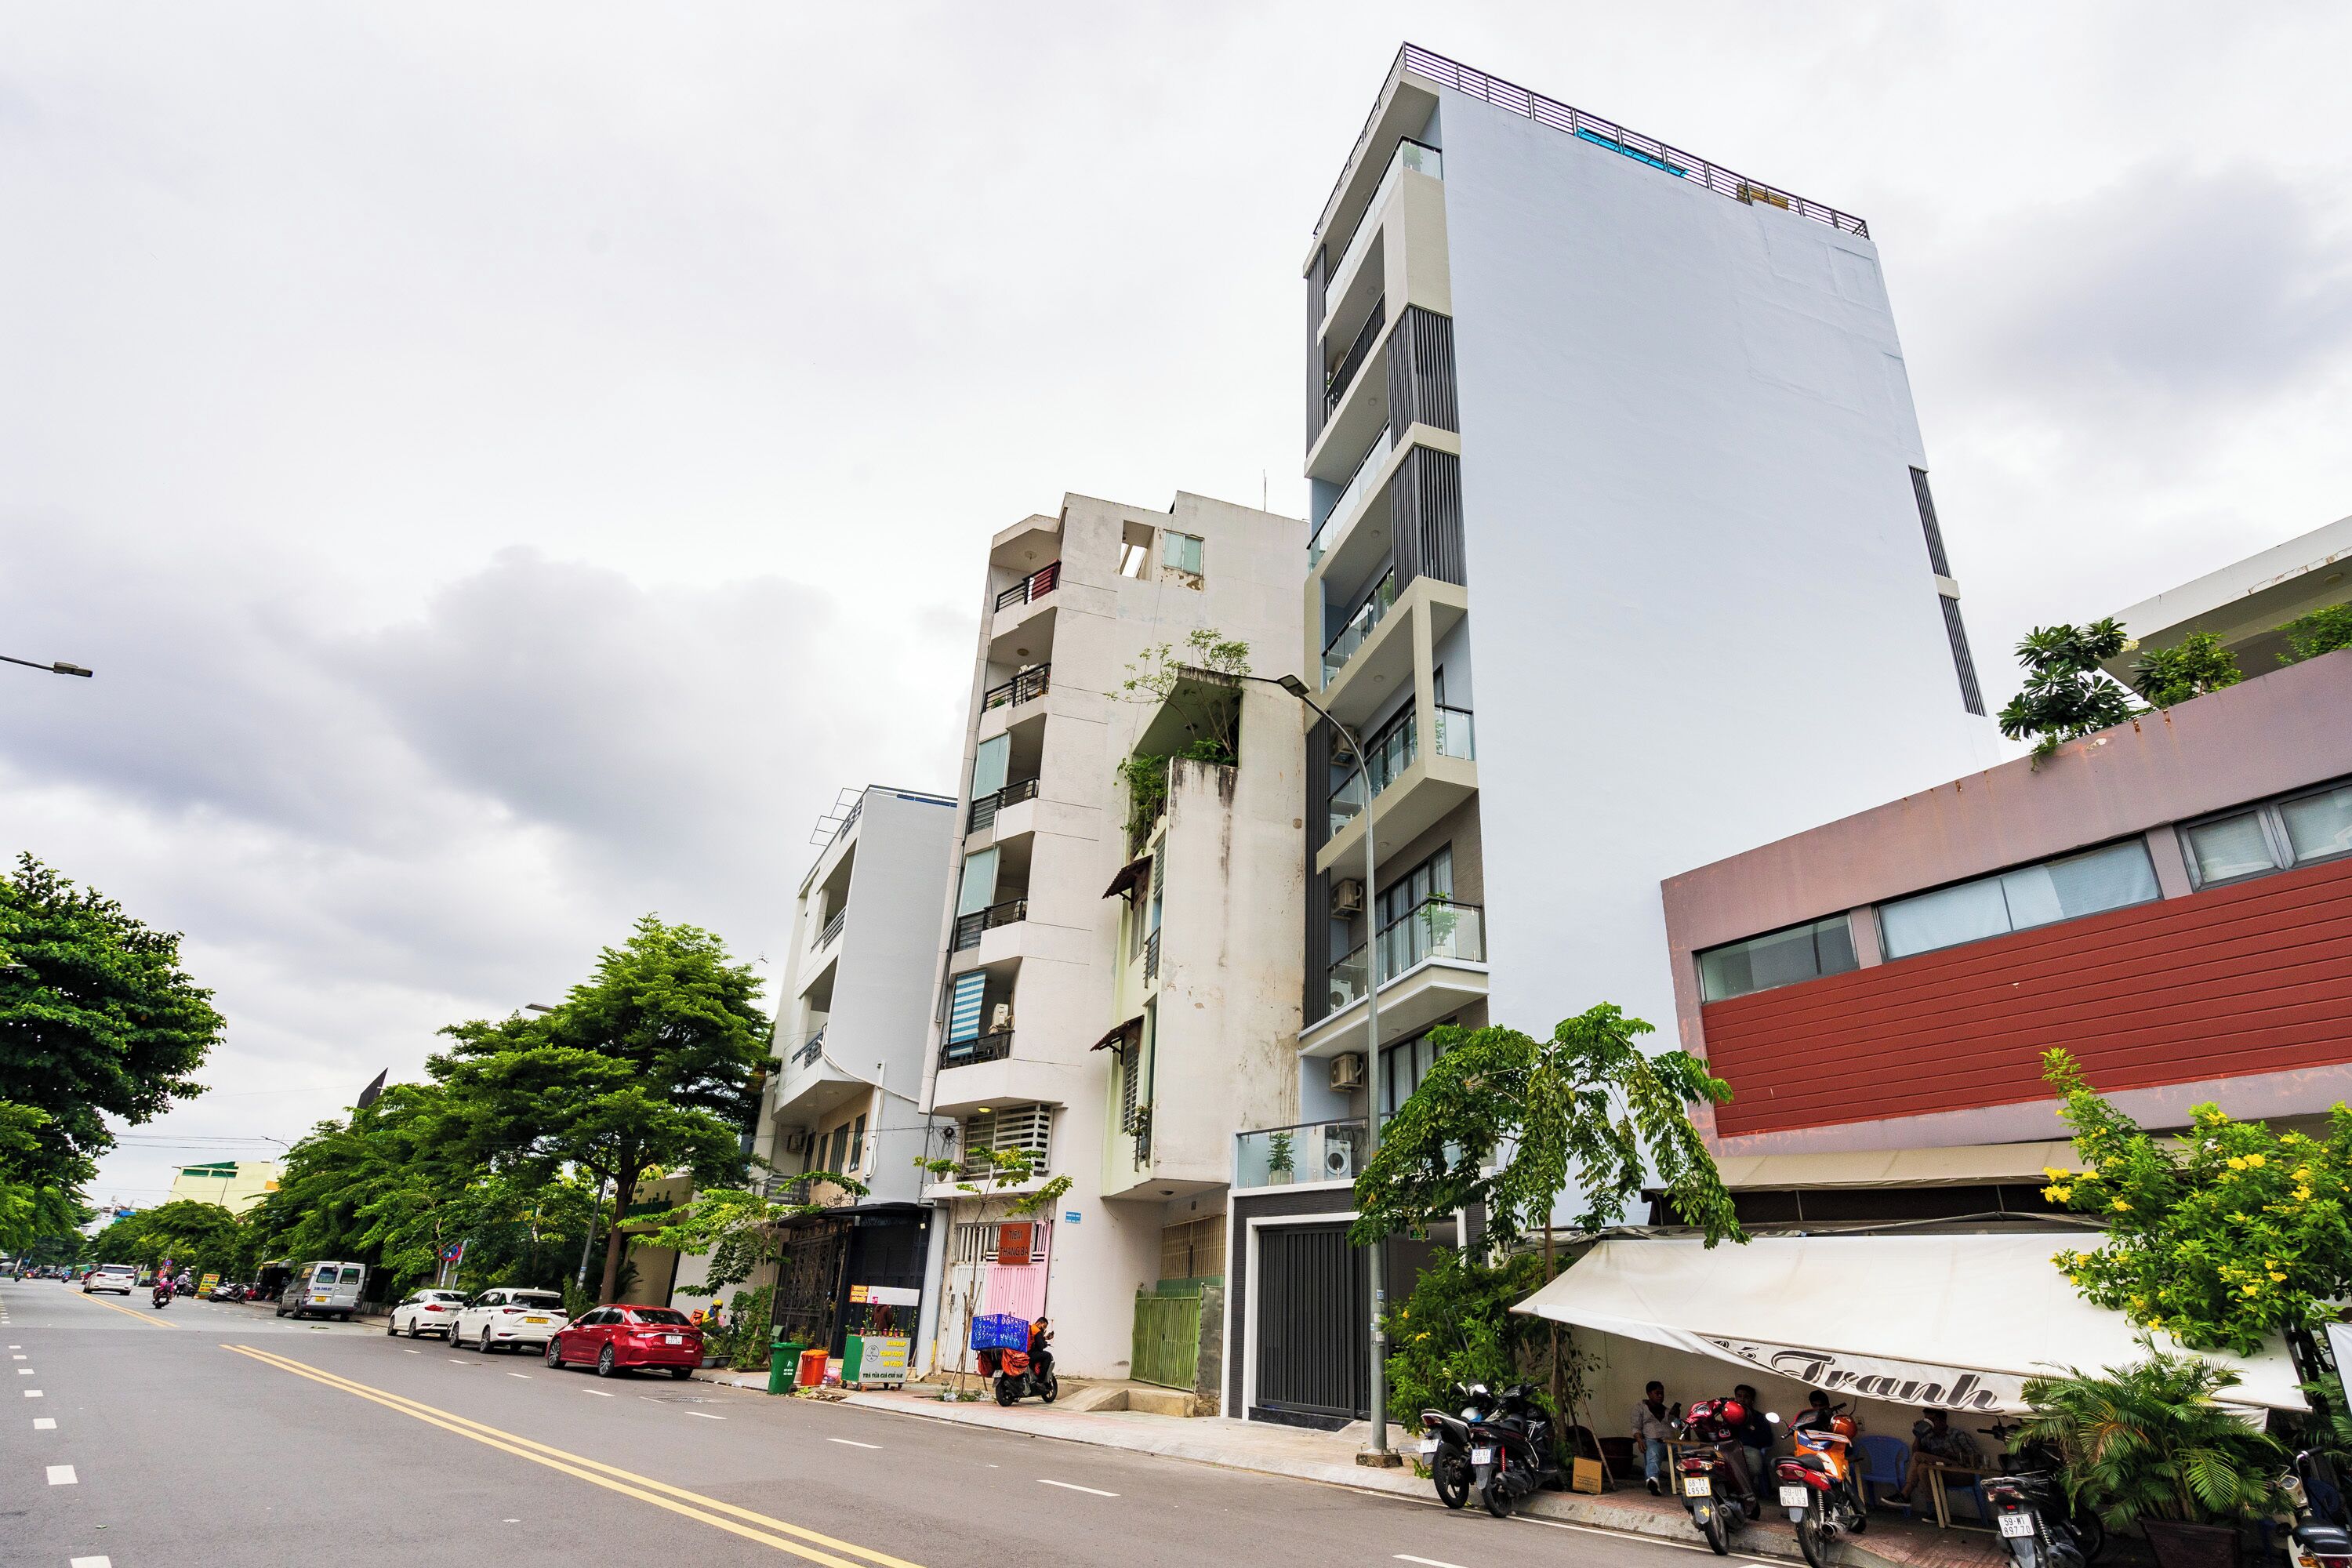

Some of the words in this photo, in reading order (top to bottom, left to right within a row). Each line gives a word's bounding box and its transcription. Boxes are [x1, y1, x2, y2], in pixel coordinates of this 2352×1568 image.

[1021, 1247, 1029, 1255] BA
[1770, 1350, 2005, 1413] Tranh
[1687, 1486, 1709, 1495] 495.51
[1782, 1496, 1806, 1504] 041.63
[2004, 1517, 2025, 1526] 59-M1
[2003, 1525, 2031, 1535] 897.70
